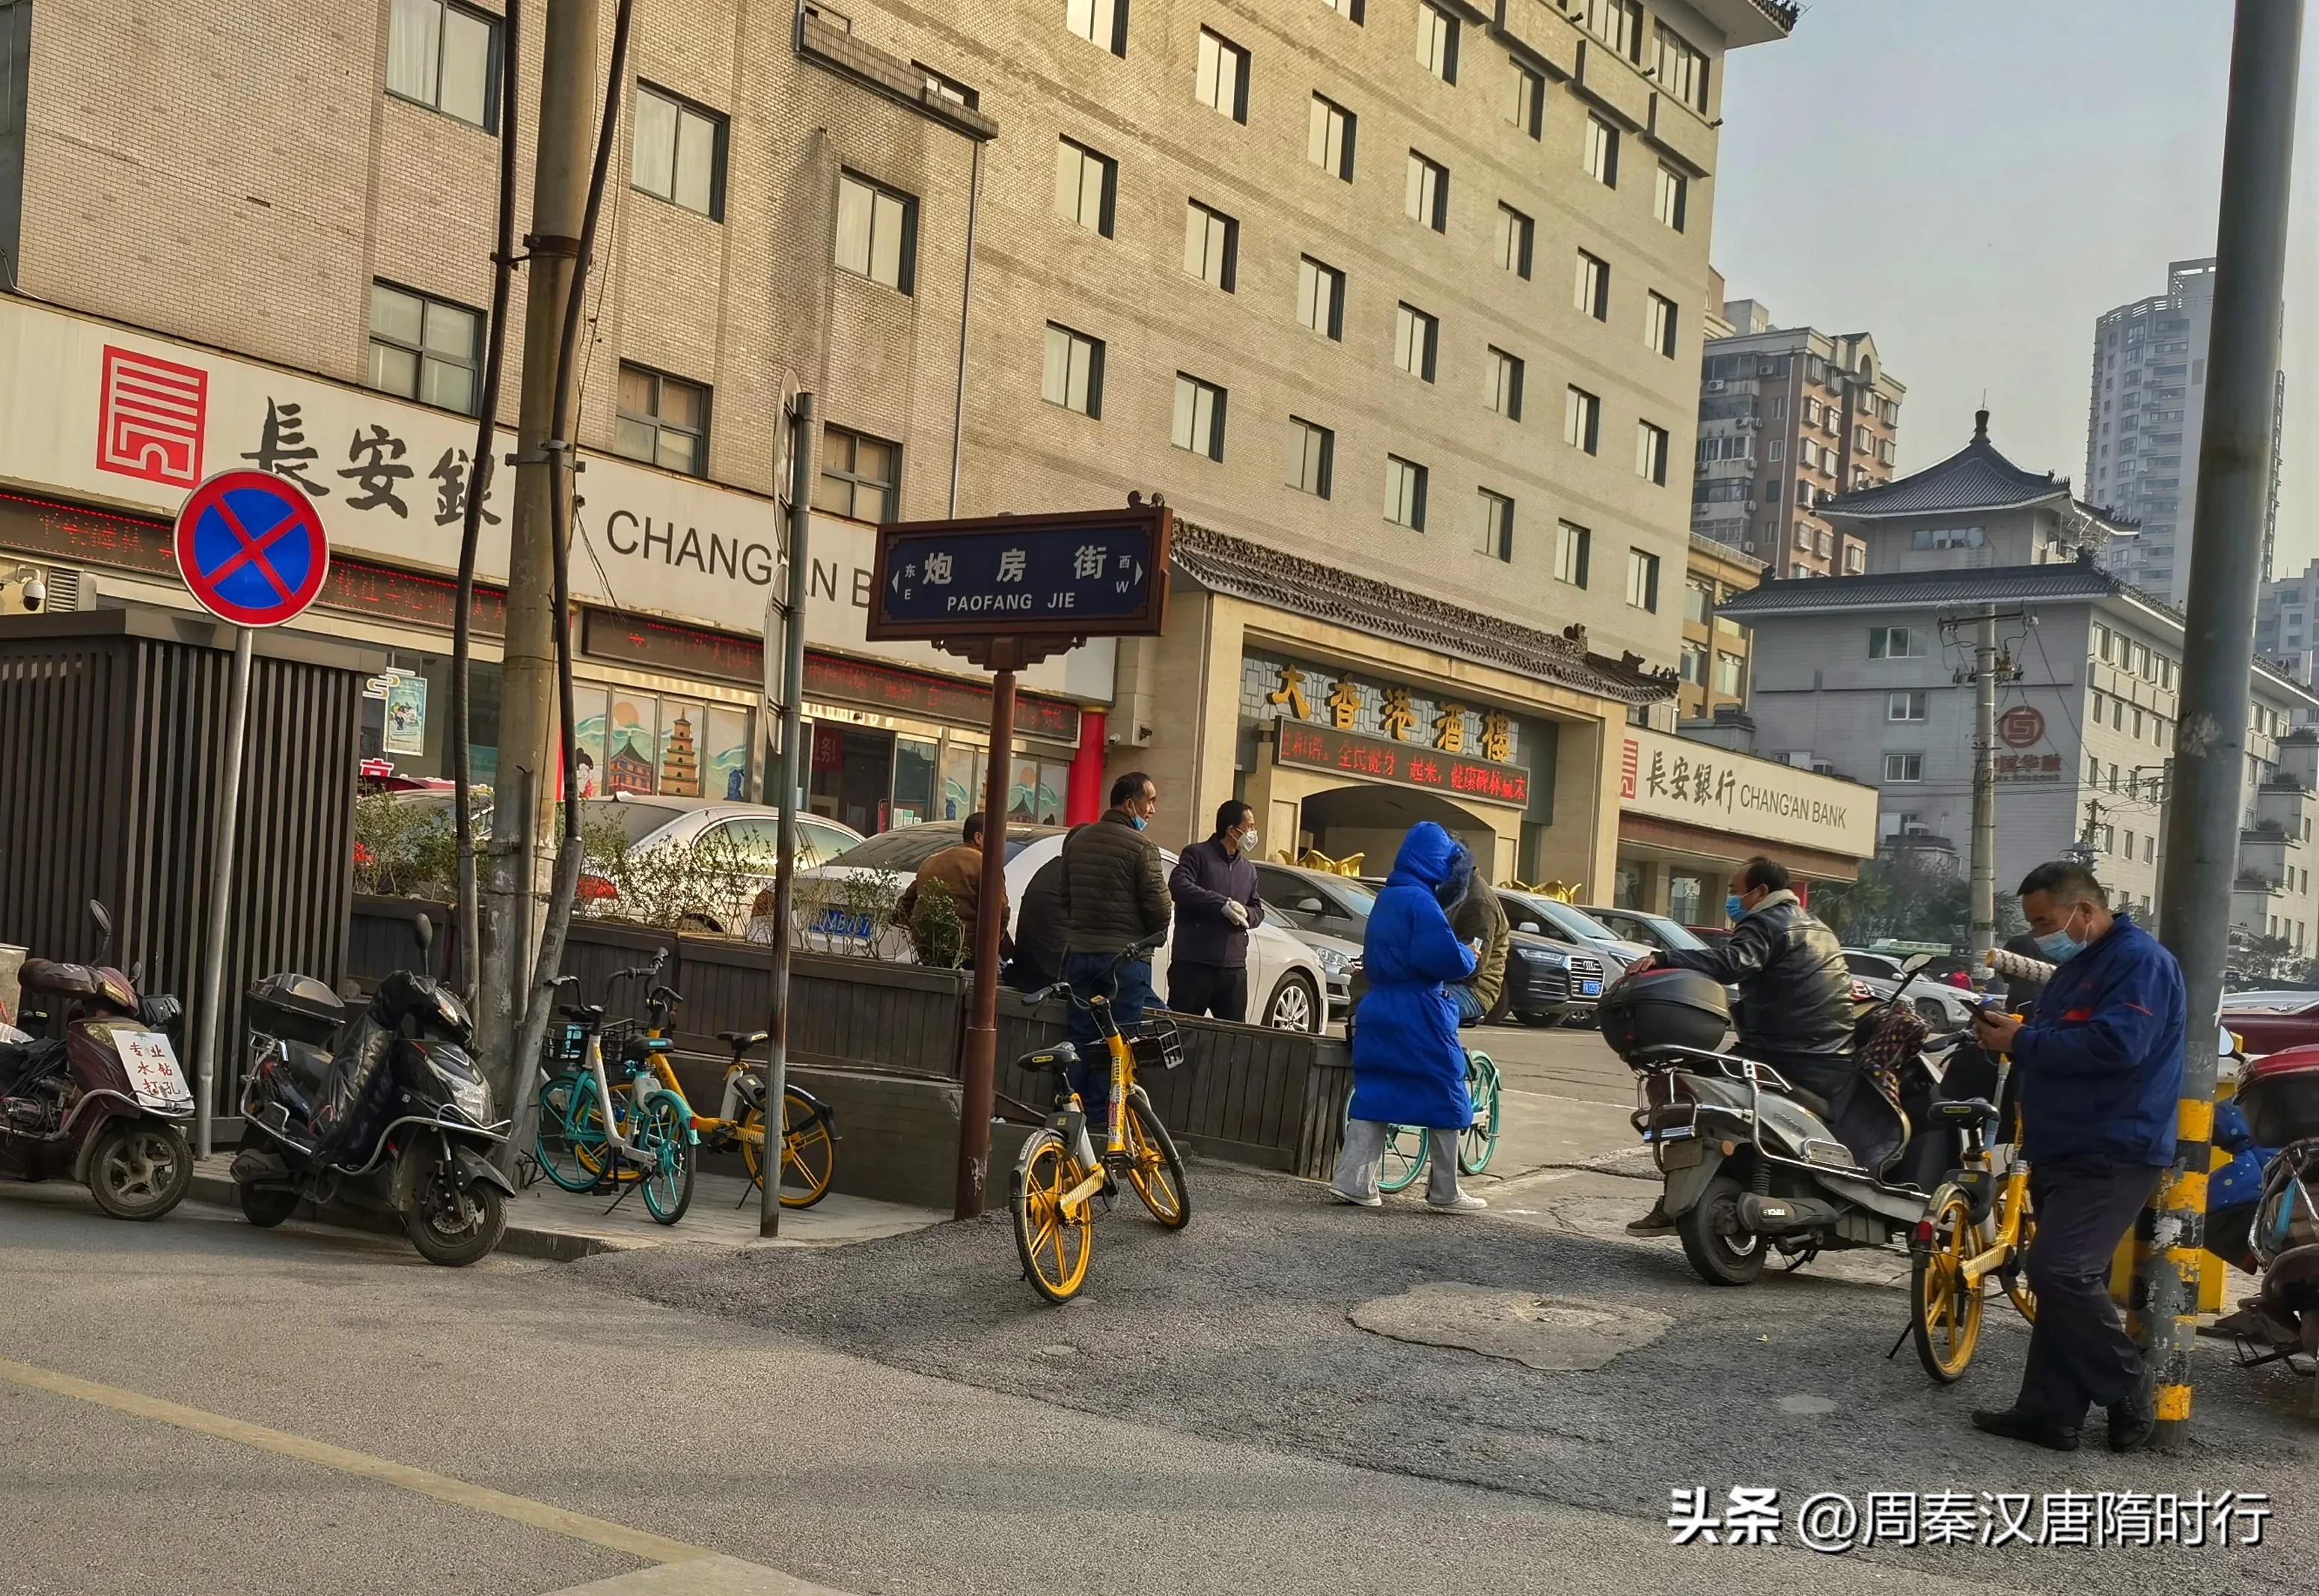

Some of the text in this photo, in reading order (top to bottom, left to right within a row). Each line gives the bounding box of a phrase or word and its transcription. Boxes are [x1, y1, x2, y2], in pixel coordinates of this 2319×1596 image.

[607, 510, 837, 602] CHANG'N
[1118, 554, 1132, 569] 西
[904, 563, 917, 579] 东
[921, 544, 1107, 586] 炮房街
[904, 588, 912, 601] E
[1115, 580, 1130, 594] W
[947, 592, 1075, 611] PAOFANG JIE
[1740, 783, 1848, 829] CHANG'AN BANK
[129, 1042, 166, 1058] 专业
[137, 1060, 173, 1077] 水钻
[142, 1078, 181, 1096] 打孔
